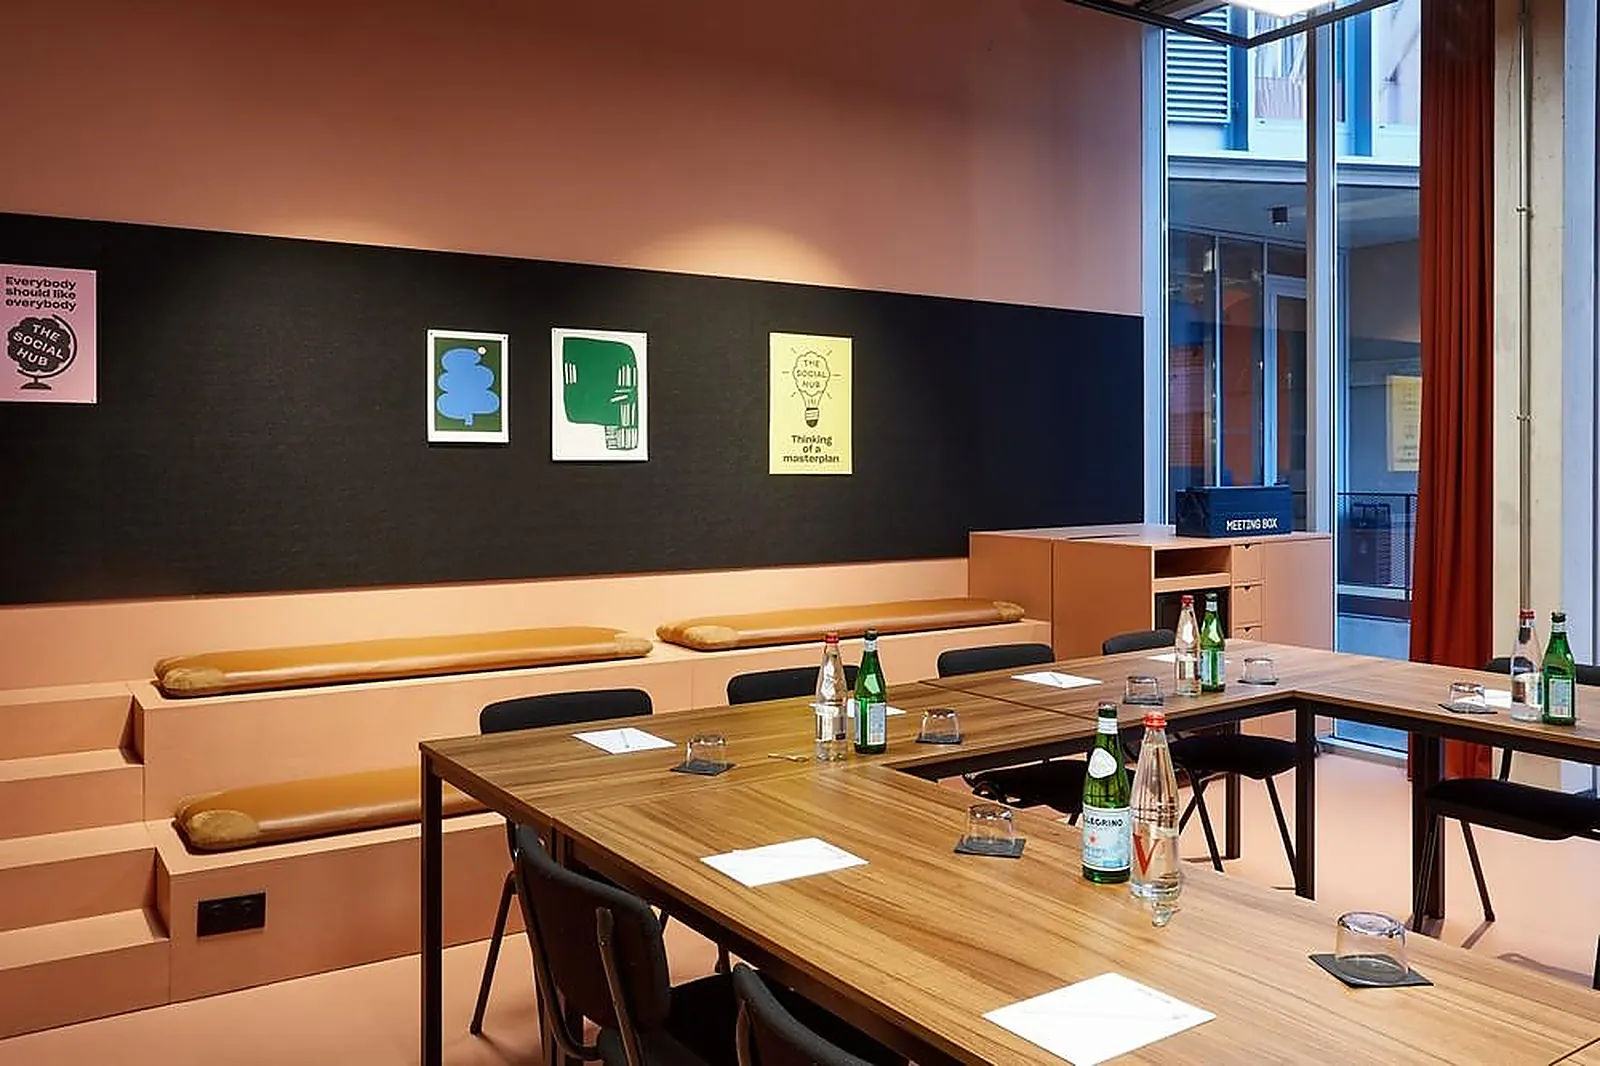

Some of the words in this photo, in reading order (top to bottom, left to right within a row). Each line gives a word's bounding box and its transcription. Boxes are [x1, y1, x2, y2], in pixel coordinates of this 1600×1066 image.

[5, 276, 77, 290] Everybody
[5, 287, 51, 298] should
[53, 289, 77, 300] like
[5, 298, 77, 312] everybody
[32, 324, 61, 342] THE
[13, 331, 64, 360] SOCIAL
[17, 347, 49, 366] HUB
[803, 359, 820, 368] THE
[796, 369, 827, 378] SOCIAL
[802, 380, 821, 389] HUB
[791, 435, 833, 447] Thinking
[802, 444, 814, 453] of
[783, 454, 840, 464] masterplan
[1226, 519, 1261, 531] MEETING
[1262, 518, 1278, 529] BOX
[1133, 833, 1159, 875] V
